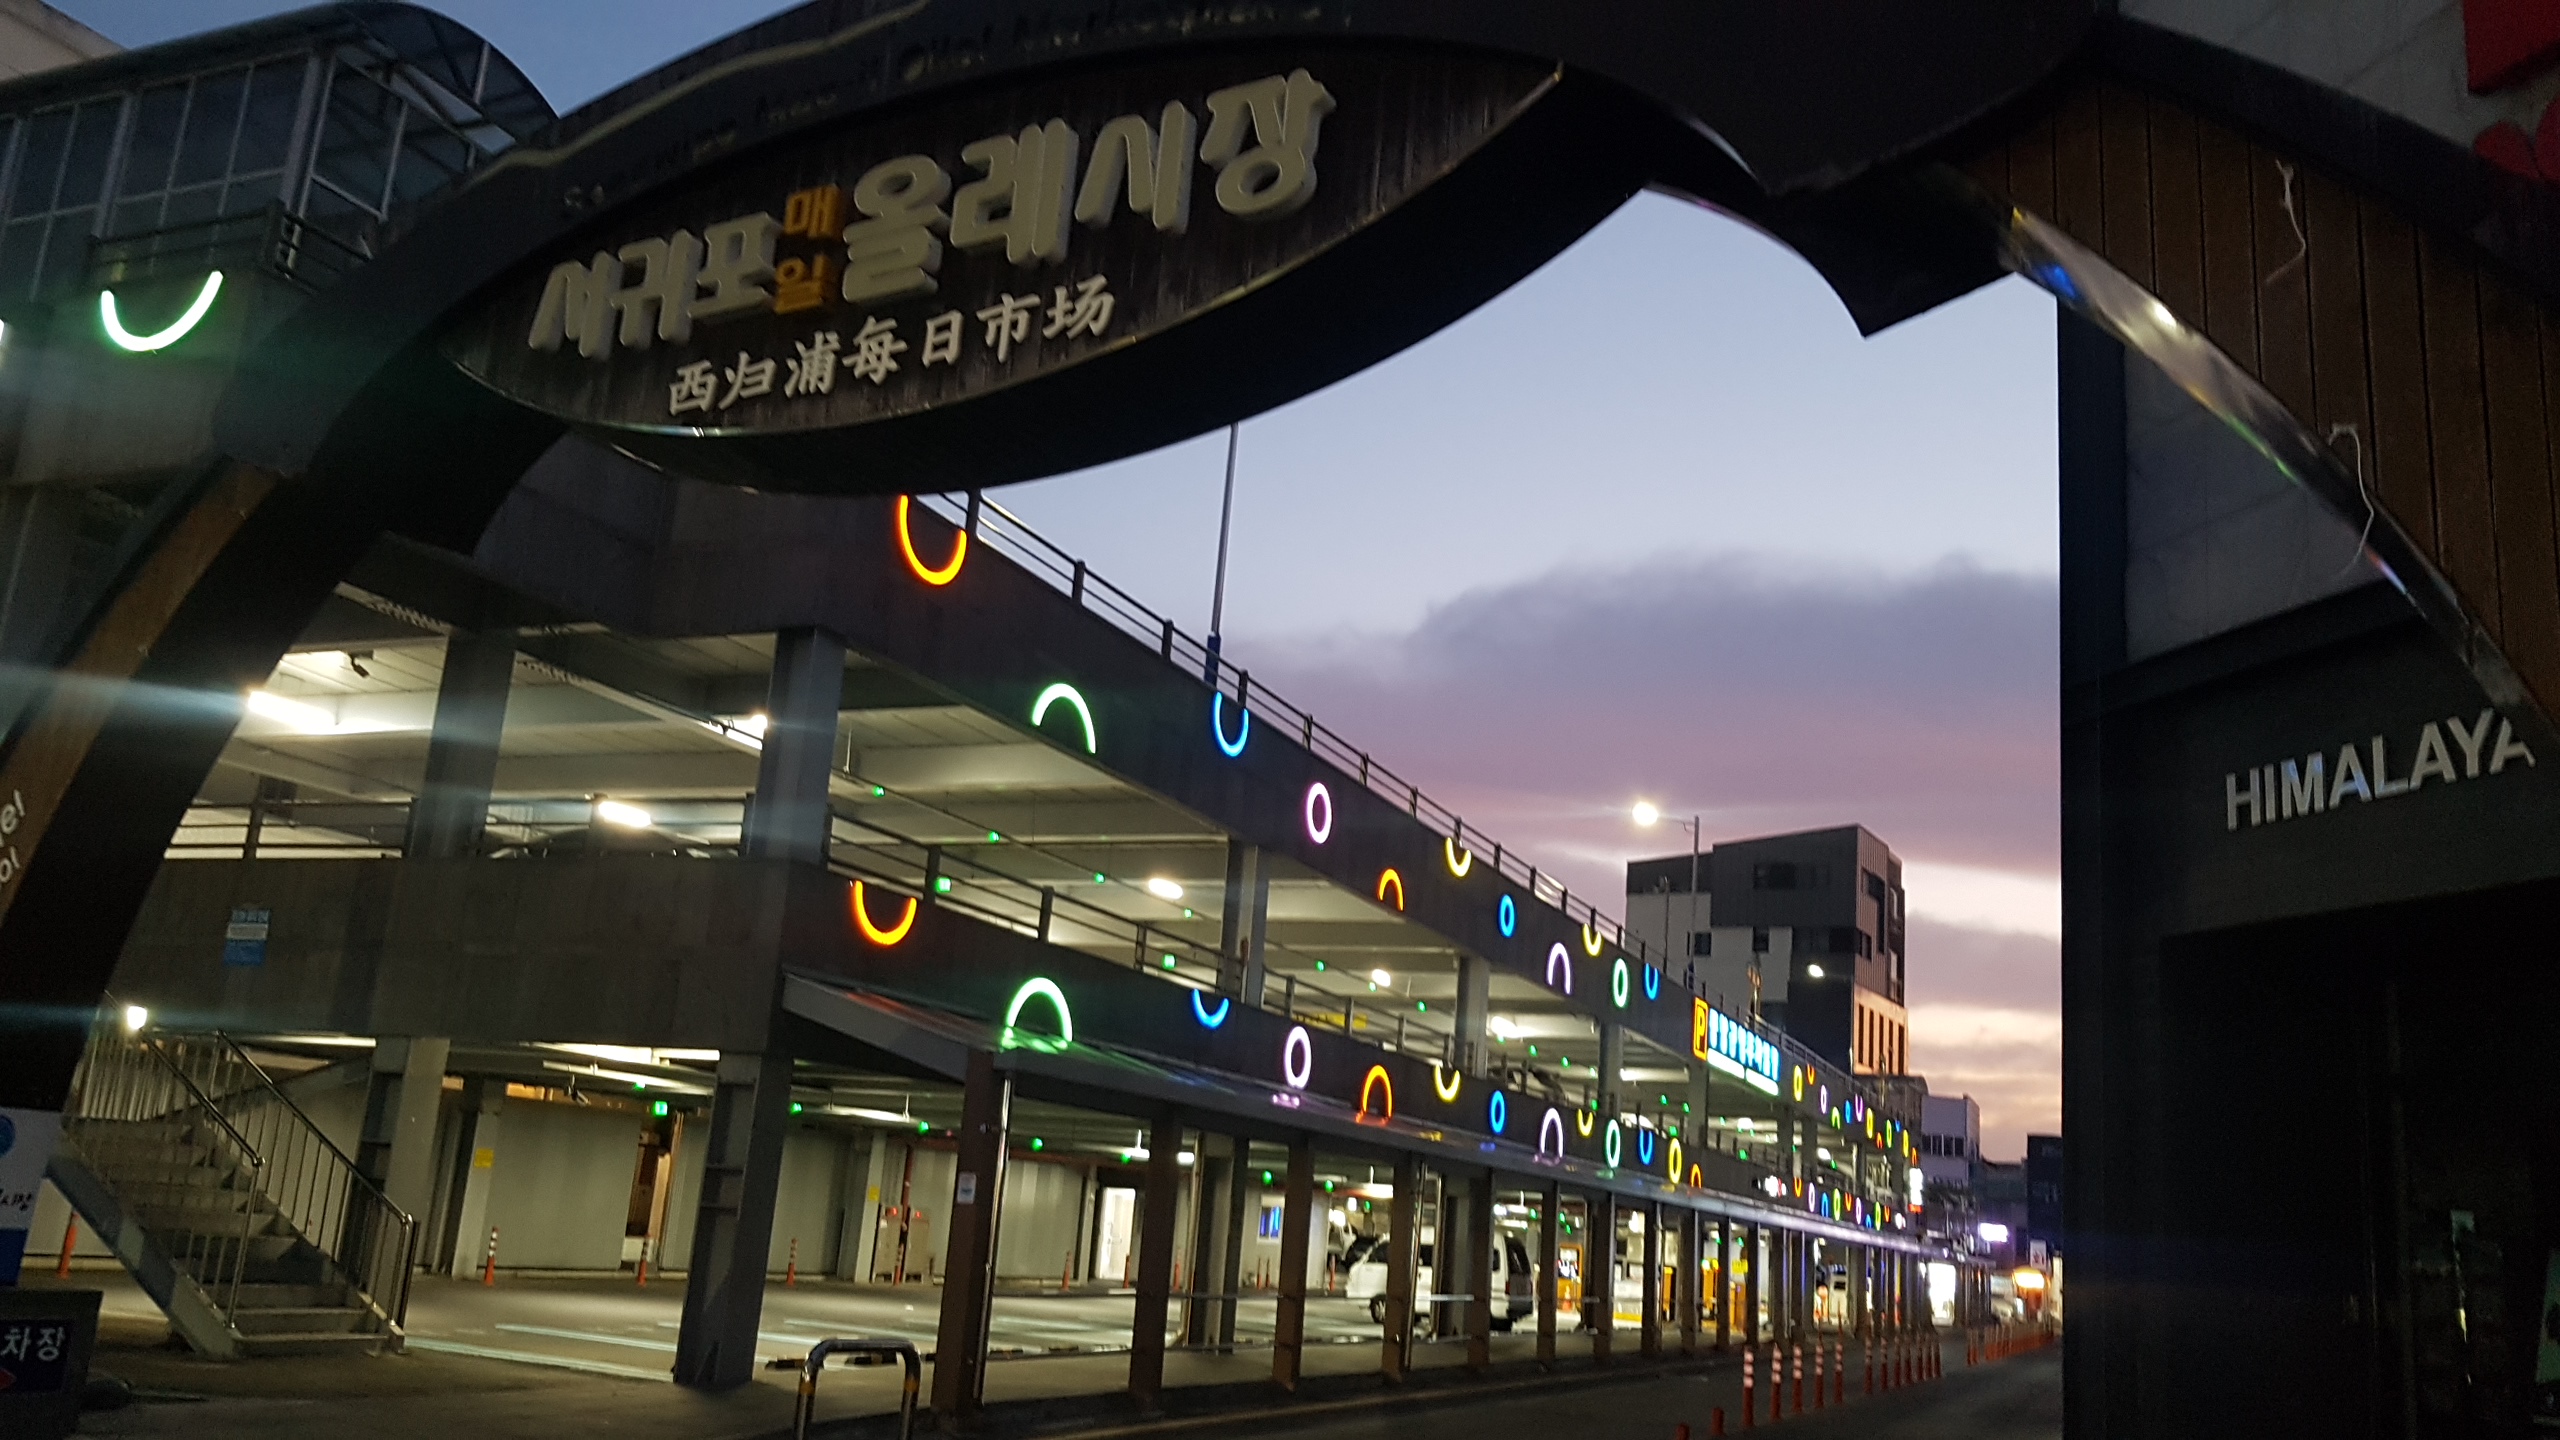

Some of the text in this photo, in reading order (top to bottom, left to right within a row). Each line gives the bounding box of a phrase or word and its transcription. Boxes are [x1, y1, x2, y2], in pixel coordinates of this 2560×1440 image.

[528, 211, 782, 360] 서귀포
[774, 182, 846, 316] 매일
[841, 68, 1337, 304] 올레시장
[667, 273, 1118, 417] 西归浦每日市场
[2225, 706, 2537, 831] HIMALAYA
